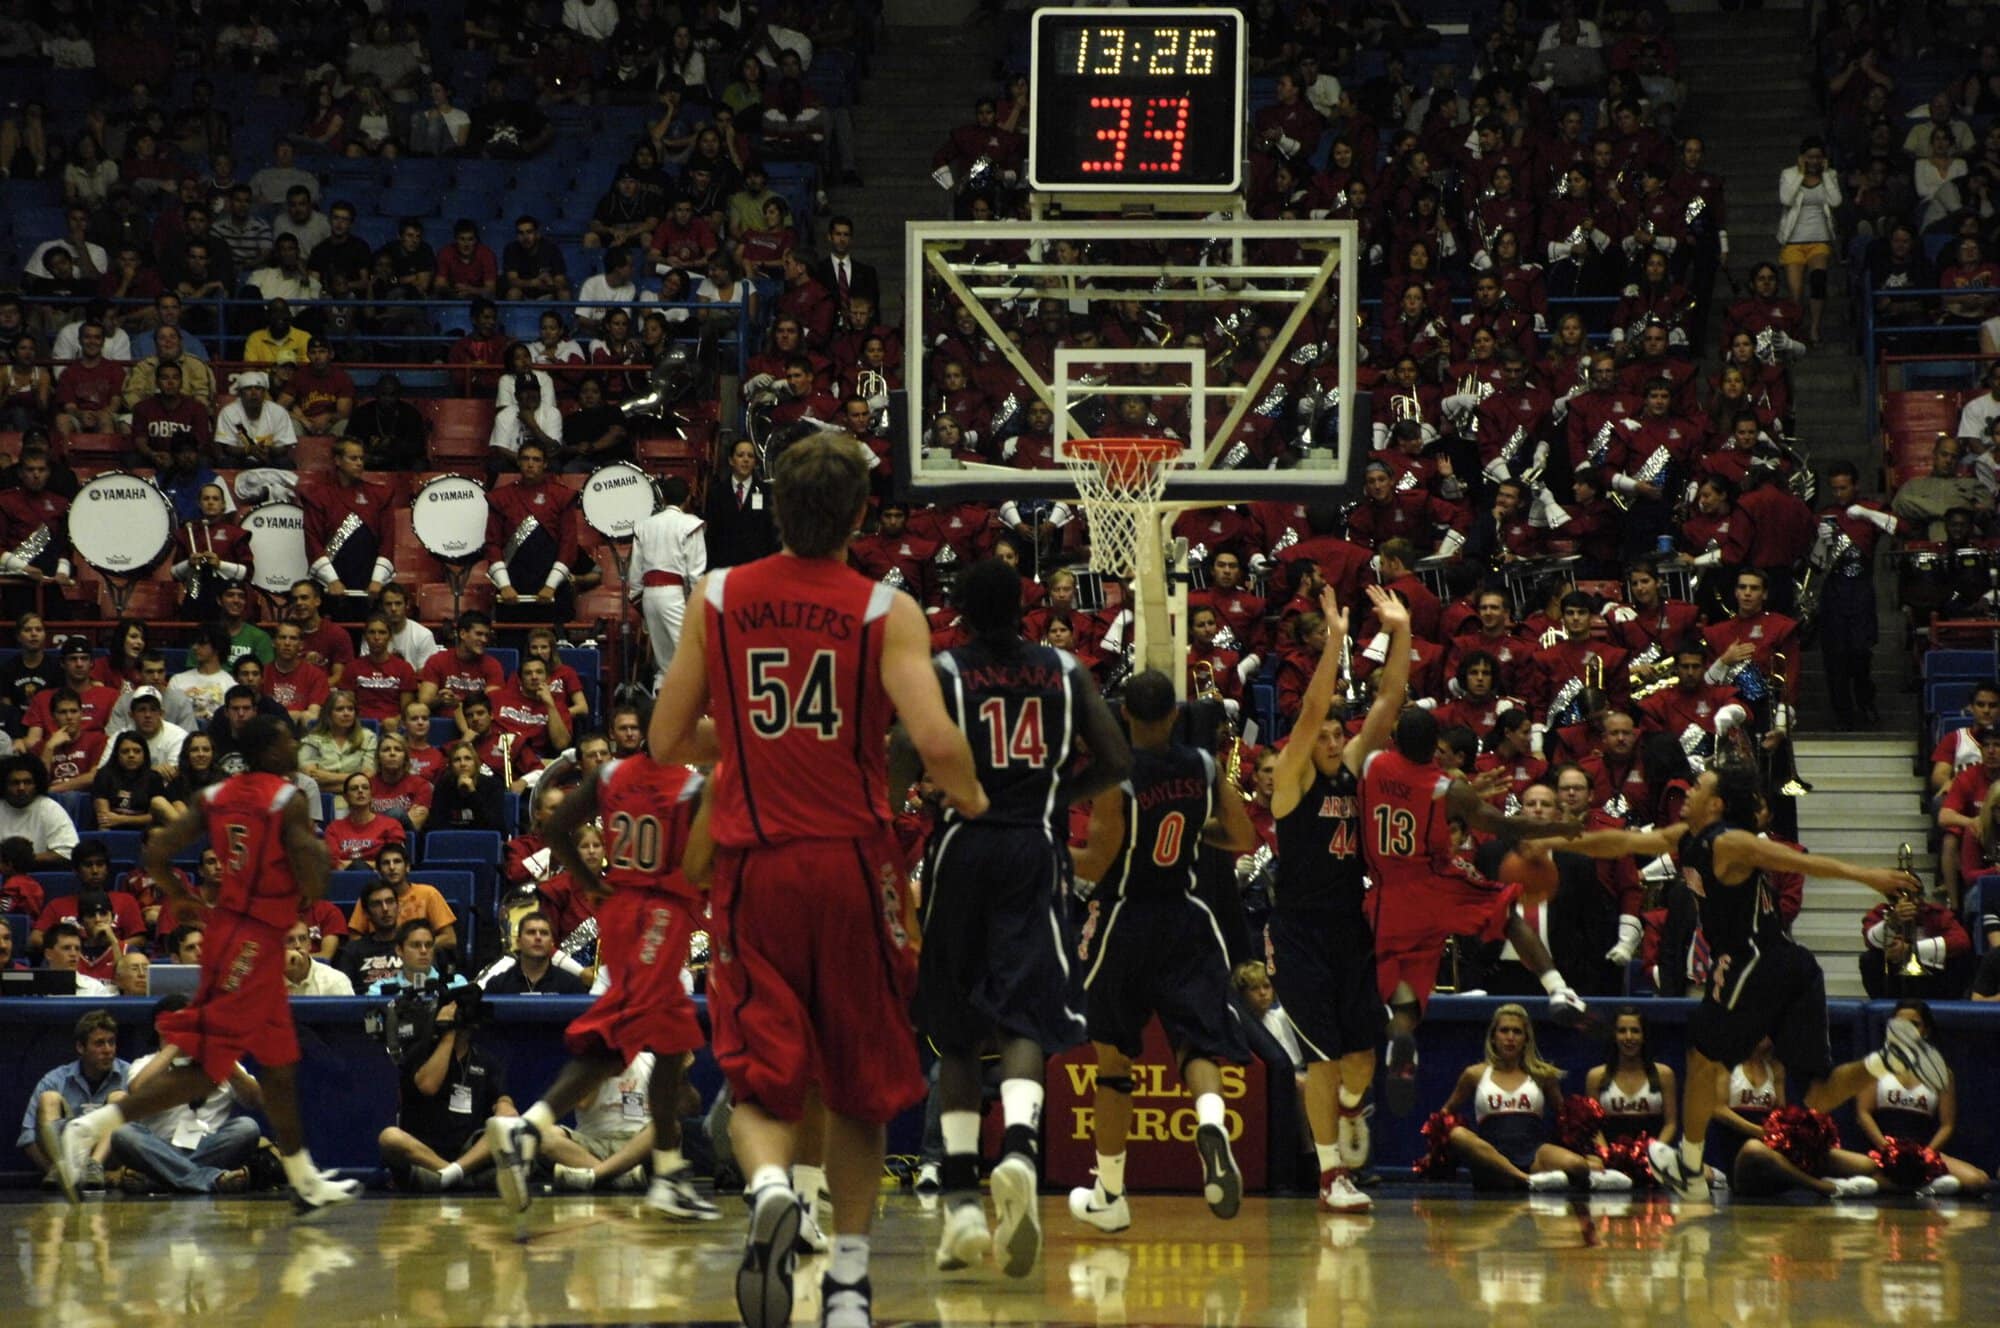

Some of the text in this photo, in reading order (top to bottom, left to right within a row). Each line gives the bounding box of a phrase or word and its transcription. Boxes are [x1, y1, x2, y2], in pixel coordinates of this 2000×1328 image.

[1077, 28, 1216, 75] 13:26
[1081, 97, 1190, 172] 39
[102, 488, 146, 500] YAMAHA
[439, 489, 474, 502] YAMAHA
[602, 474, 638, 491] YAMAHA
[266, 516, 303, 529] YAMAH
[732, 602, 855, 640] WALTERS
[747, 648, 843, 741] 54
[979, 696, 1048, 769] 14
[225, 824, 249, 875] 5
[609, 811, 663, 872] 20
[1152, 810, 1185, 867] 0
[1373, 803, 1417, 857] 13
[361, 955, 404, 971] ZON
